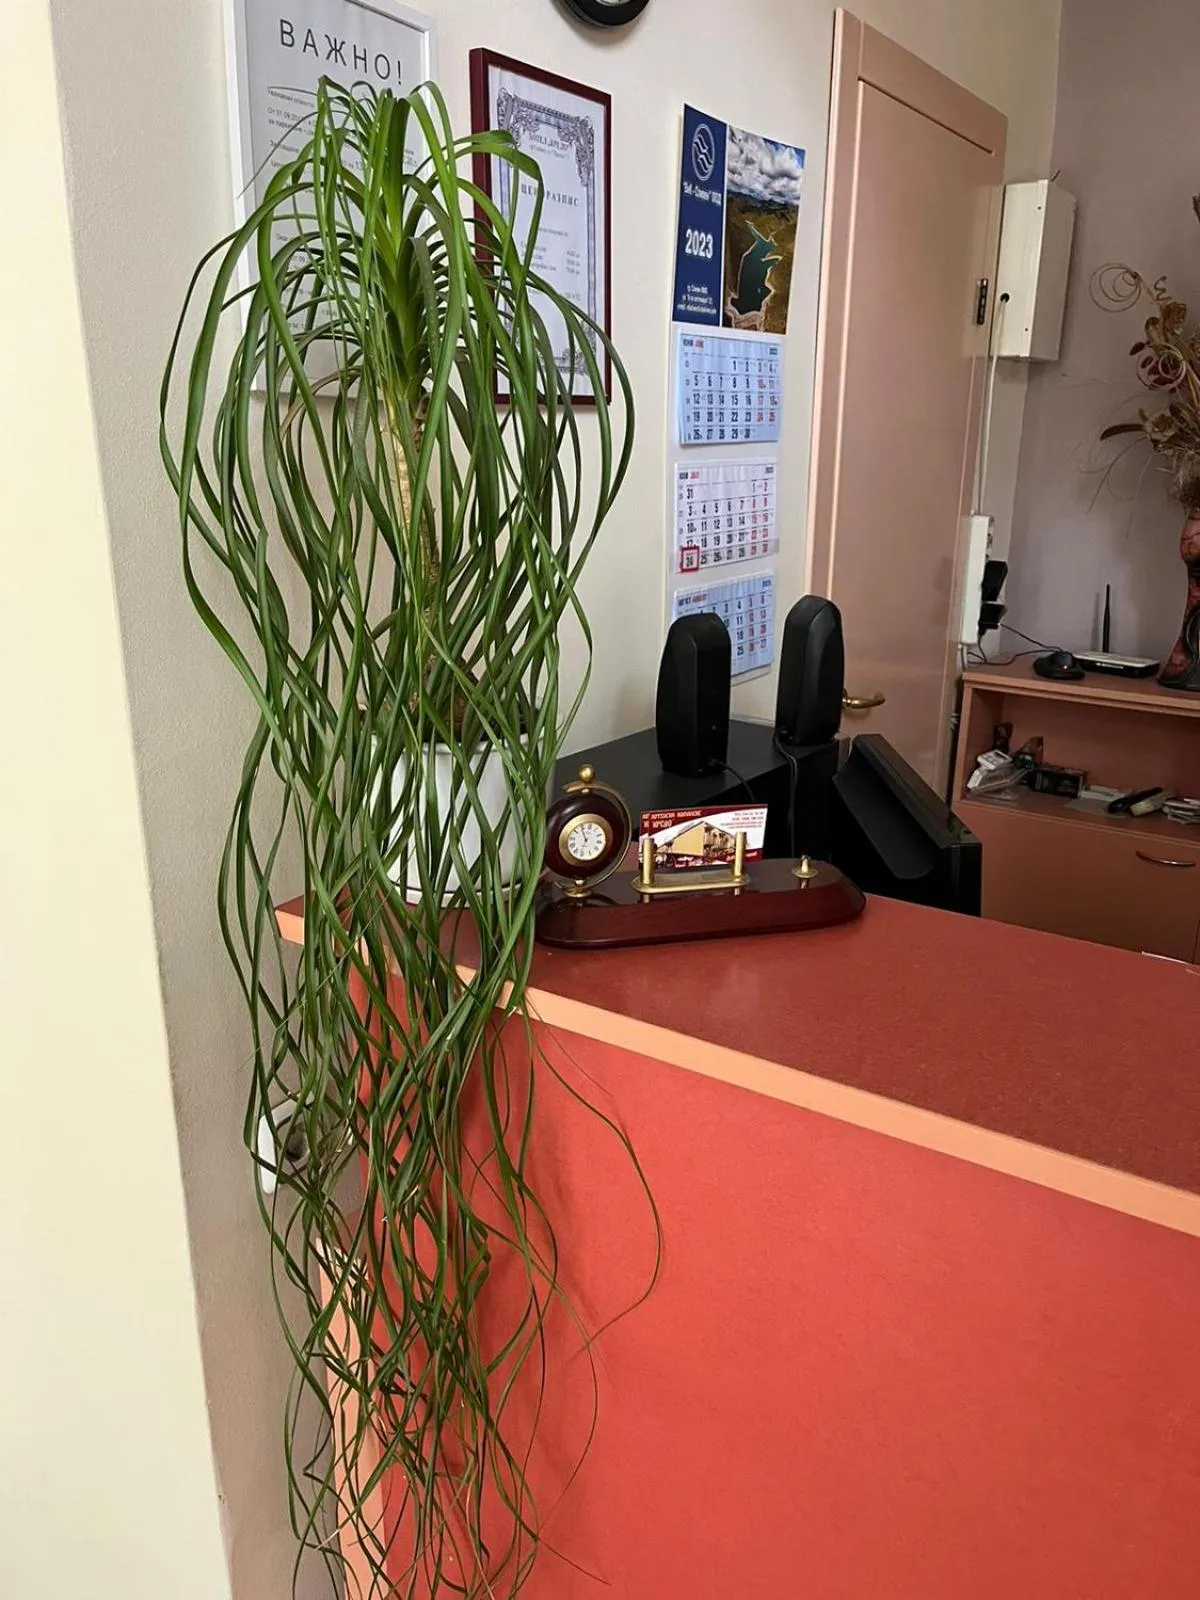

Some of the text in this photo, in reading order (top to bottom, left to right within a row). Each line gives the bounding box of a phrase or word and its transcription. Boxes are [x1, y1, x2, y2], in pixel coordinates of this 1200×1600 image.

[279, 18, 402, 85] ВАЖНО!
[685, 229, 713, 259] 2023
[693, 393, 700, 405] 12
[706, 393, 714, 405] 13
[718, 394, 725, 405] 14
[731, 394, 739, 406] 15
[745, 395, 752, 406] 16
[693, 411, 700, 422] 19
[706, 411, 714, 422] 20
[718, 411, 725, 423] 21
[731, 411, 739, 422] 22
[745, 411, 752, 422] 23
[693, 428, 751, 440] 26 27 28 29 30
[686, 488, 694, 500] 31
[686, 522, 694, 534] 10
[701, 520, 707, 531] 11
[713, 519, 720, 530] 12
[726, 517, 733, 528] 13
[738, 515, 746, 526] 14
[700, 537, 708, 548] 18
[713, 535, 720, 546] 19
[726, 533, 733, 544] 20
[738, 532, 745, 542] 21
[686, 556, 694, 567] 24
[700, 554, 708, 565] 25
[713, 552, 721, 563] 26
[738, 547, 745, 558] 28
[736, 615, 743, 626] 11
[736, 630, 744, 641] 18
[737, 645, 744, 657] 25
